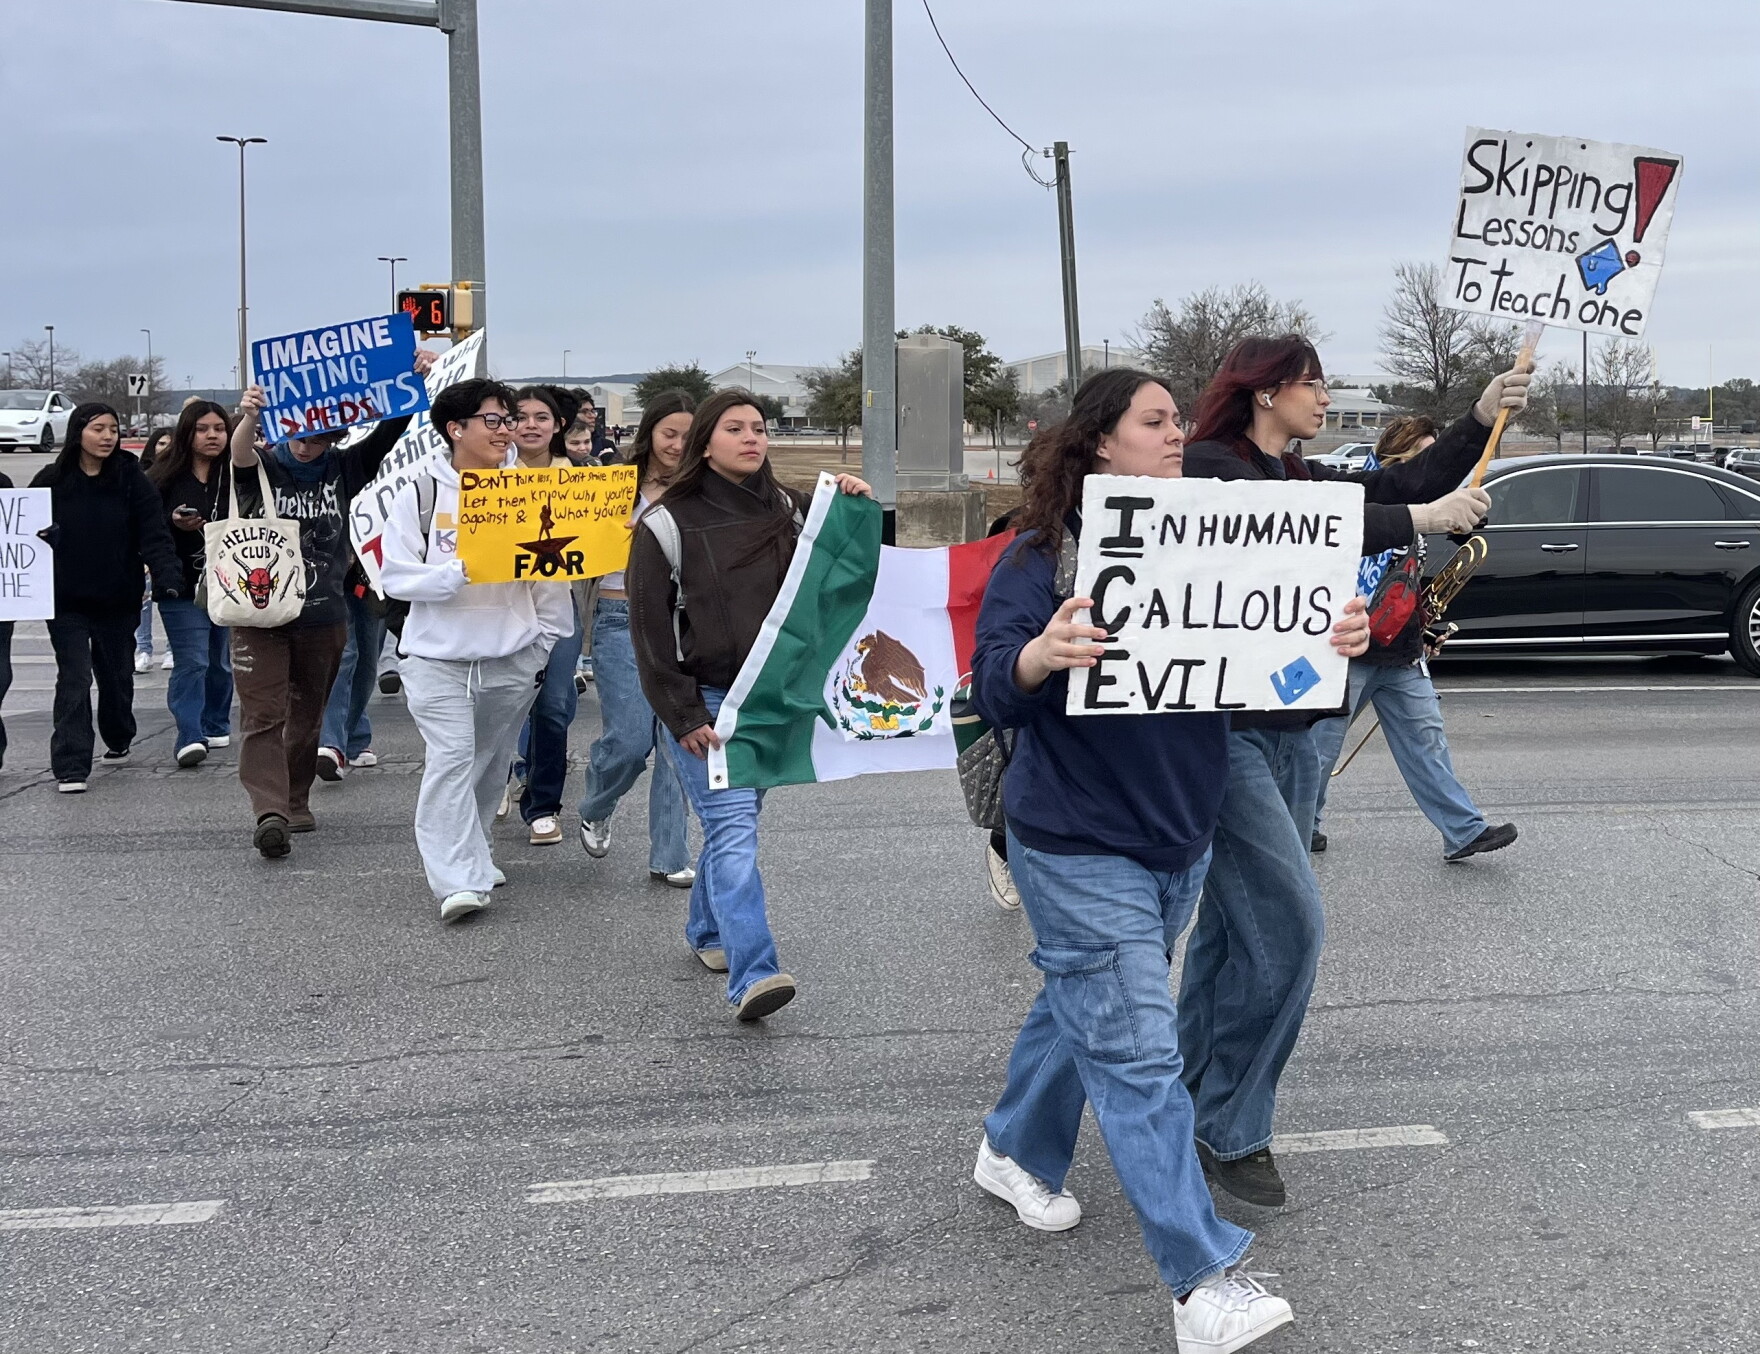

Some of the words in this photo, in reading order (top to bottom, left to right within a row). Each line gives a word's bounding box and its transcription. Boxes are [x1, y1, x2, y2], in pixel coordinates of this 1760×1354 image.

[1457, 198, 1579, 253] Lessons
[1451, 257, 1487, 303] To
[1490, 258, 1570, 319] teach
[1578, 299, 1643, 336] one
[431, 300, 442, 324] 6
[259, 318, 393, 371] IMAGINE
[257, 354, 370, 407] HATING
[558, 468, 586, 485] Don't
[464, 494, 488, 508] Let
[497, 496, 527, 508] them
[531, 488, 570, 503] know
[573, 489, 596, 502] who
[604, 486, 634, 506] you're
[0, 496, 30, 536] VE
[460, 511, 508, 535] against
[516, 509, 528, 524] &
[594, 504, 628, 522] you're
[222, 526, 288, 550] HELLFIRE
[241, 546, 271, 559] CLUB
[514, 550, 585, 579] FOR
[0, 572, 32, 598] HE
